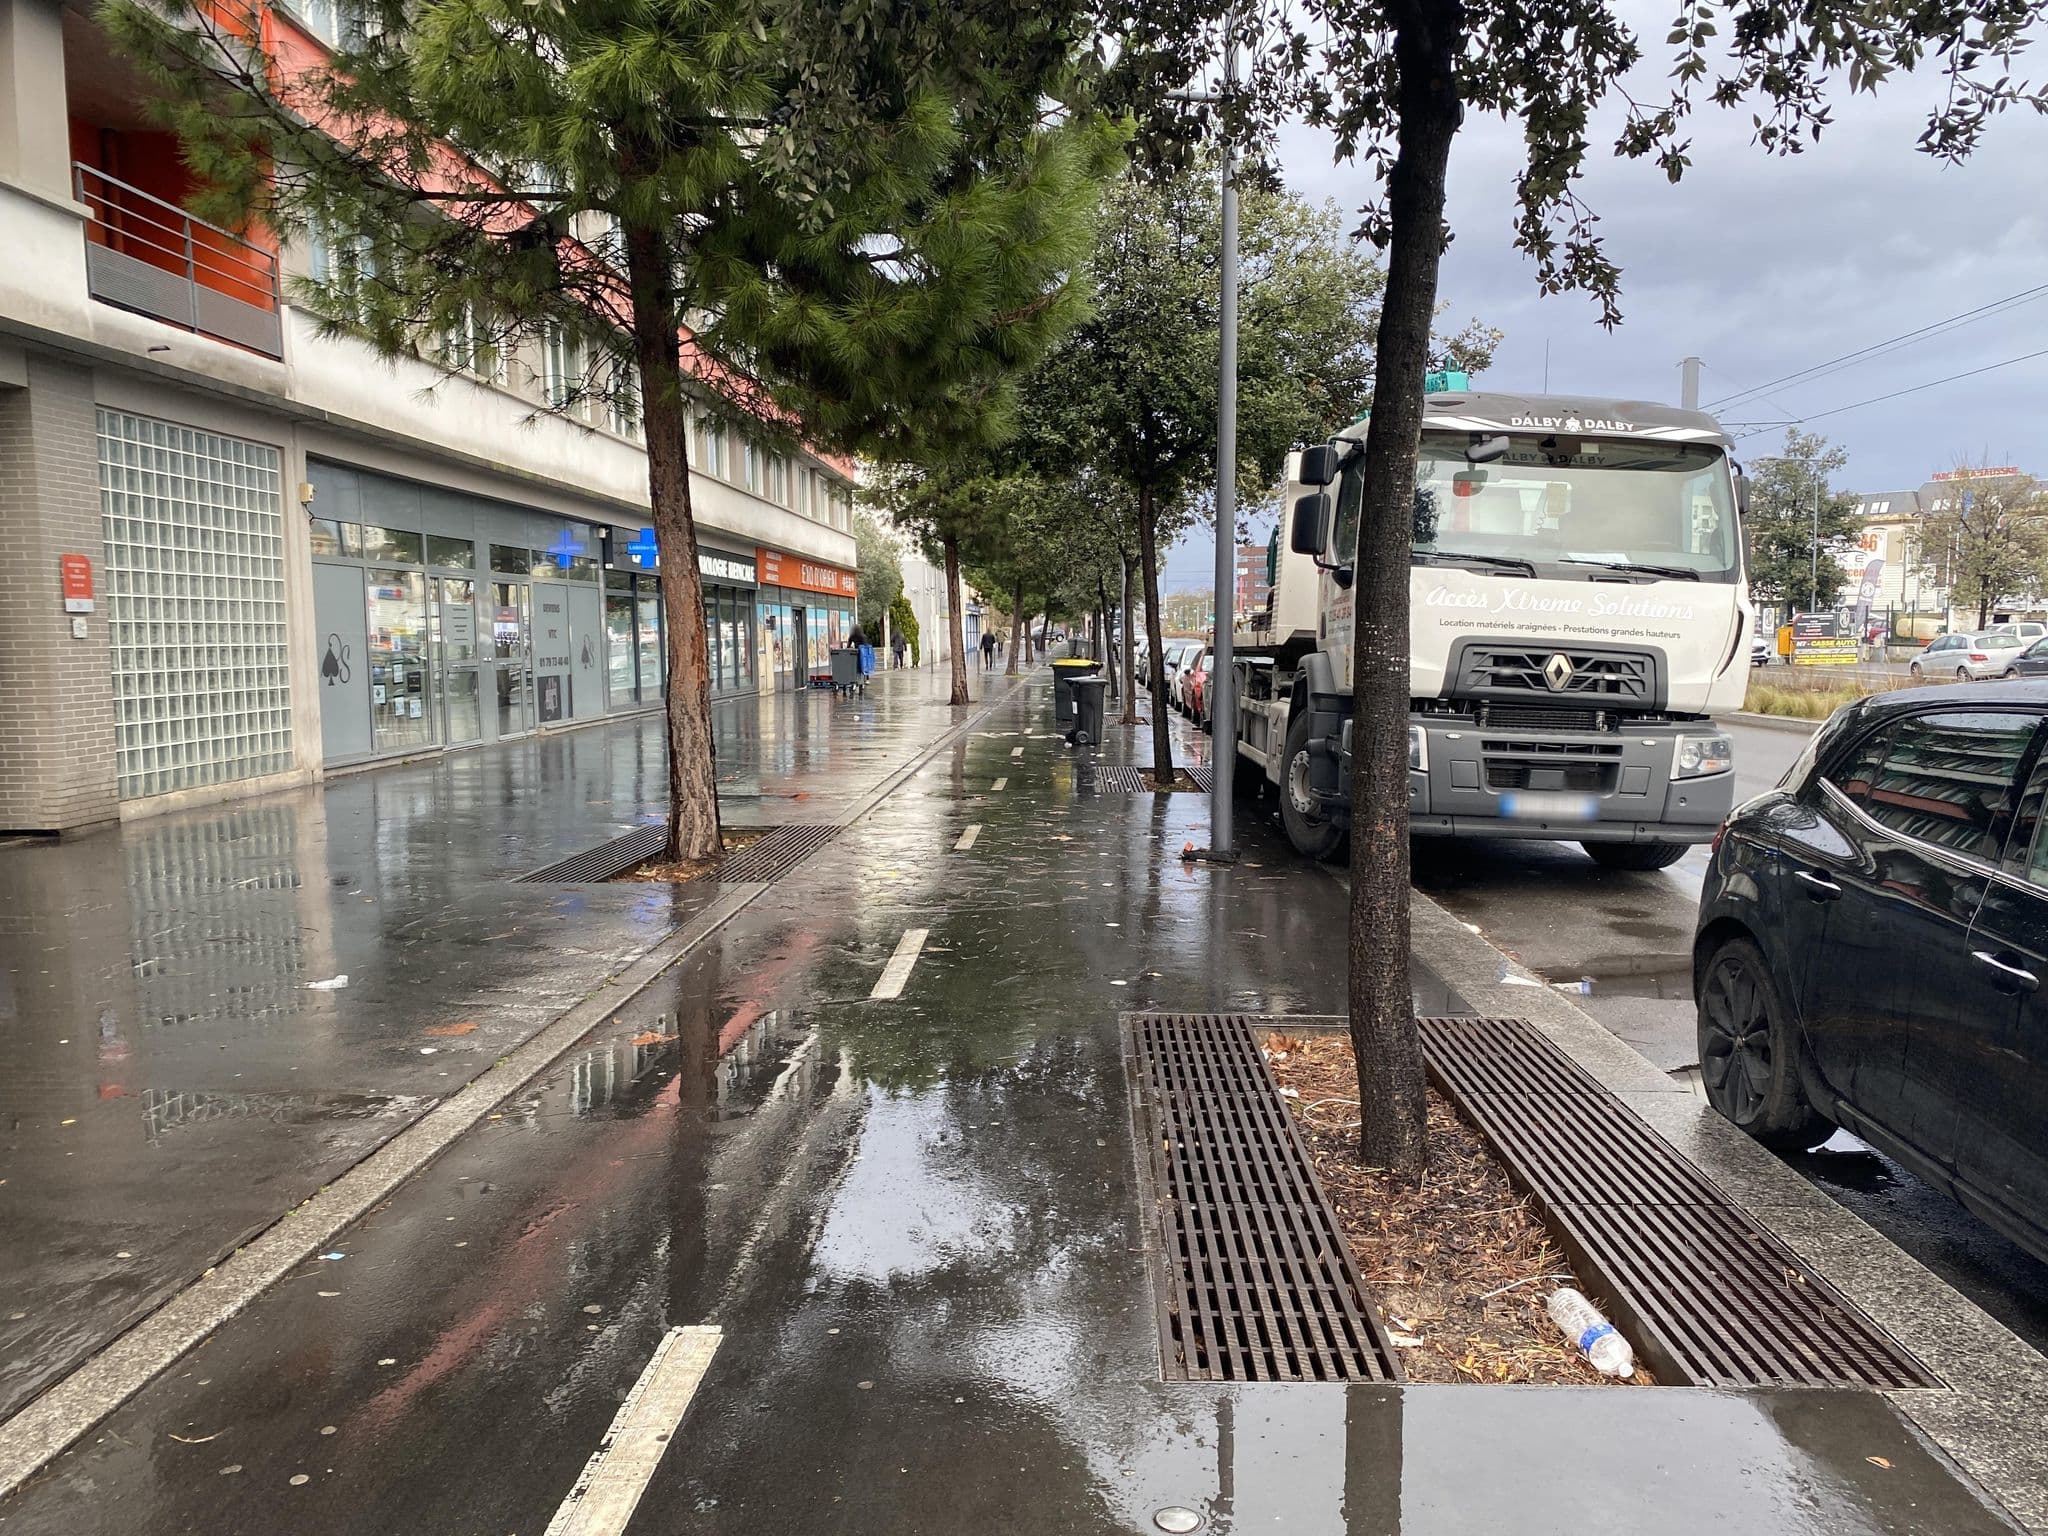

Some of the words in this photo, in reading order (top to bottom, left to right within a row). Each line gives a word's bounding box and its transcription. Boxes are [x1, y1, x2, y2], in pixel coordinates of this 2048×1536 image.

[1511, 417, 1563, 427] DALBY
[1584, 419, 1634, 431] DALBY
[1502, 453, 1537, 461] ALBY
[1425, 585, 1488, 608] Accès
[1490, 588, 1583, 614] Xtreme
[1588, 591, 1696, 620] Solutions
[1439, 618, 1475, 627] Location
[1476, 619, 1515, 630] matériels
[1516, 621, 1557, 633] araignées
[1563, 624, 1609, 635] Prestations
[1611, 628, 1644, 638] grandes
[1646, 628, 1681, 640] hauteurs
[1836, 639, 1857, 647] AUTO
